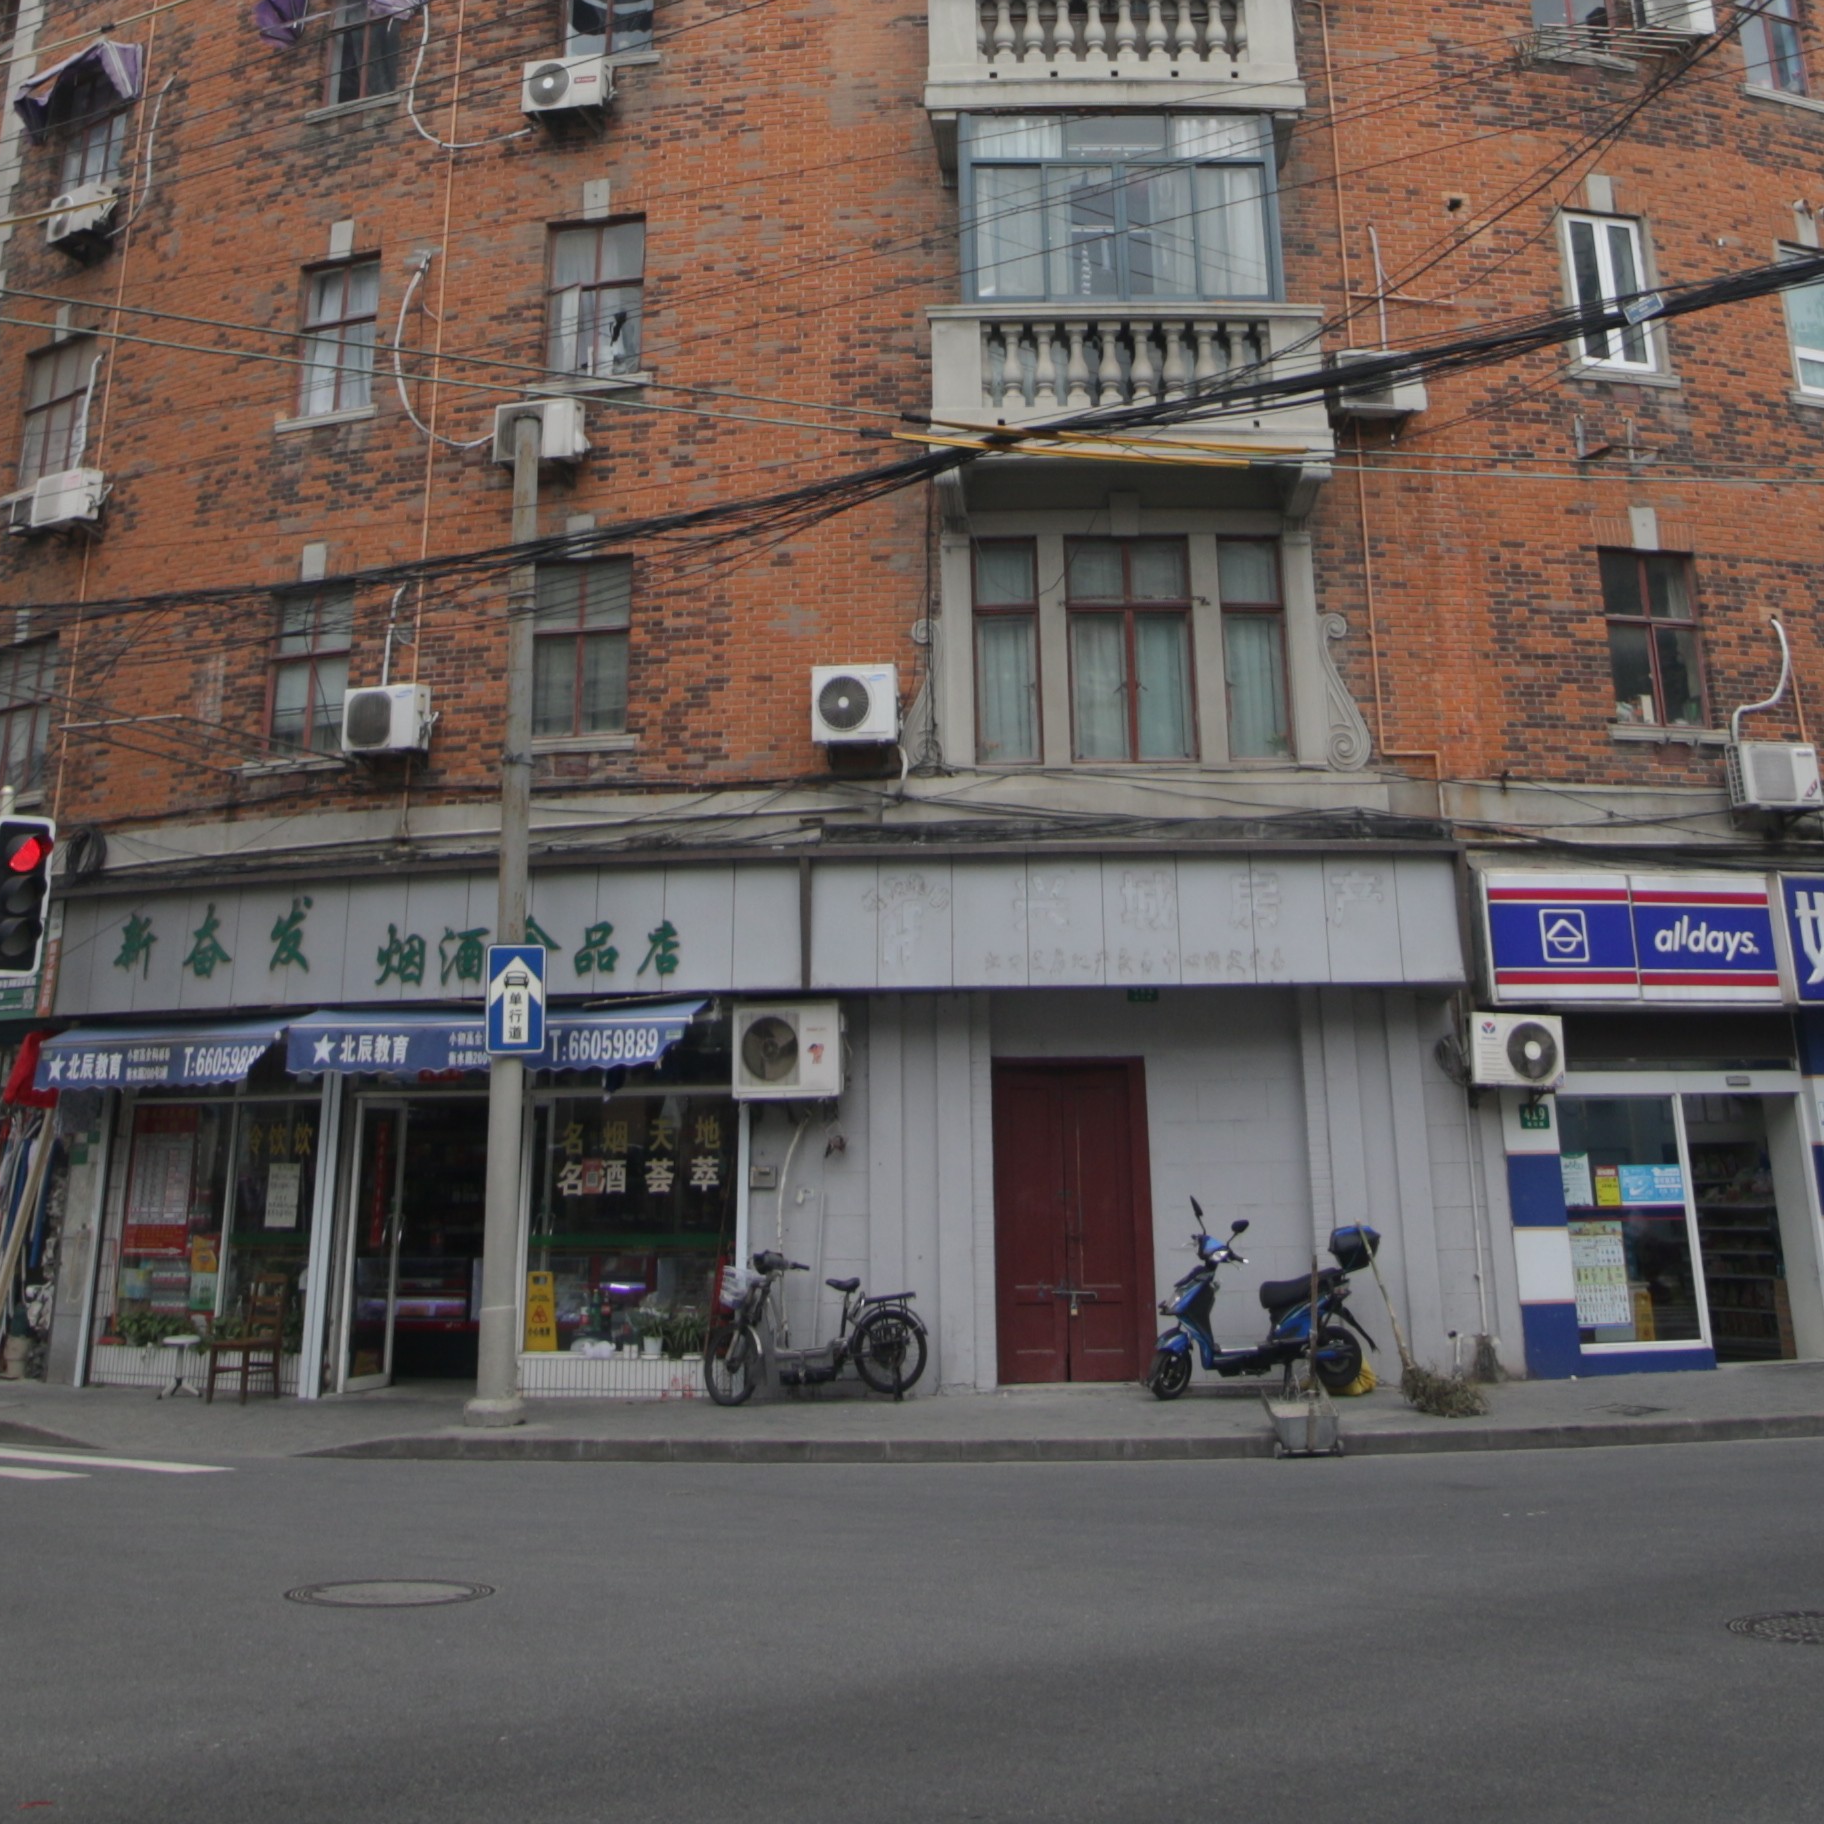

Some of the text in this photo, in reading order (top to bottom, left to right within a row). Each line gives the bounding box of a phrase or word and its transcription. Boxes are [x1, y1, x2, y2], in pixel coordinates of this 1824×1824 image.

[113, 895, 311, 980] 新奋发
[1654, 915, 1755, 961] alldays
[508, 992, 523, 1040] 单行道
[66, 1052, 123, 1081] 北辰教育
[339, 1033, 409, 1064] 北辰教育
[560, 1115, 721, 1155] 名烟天地
[557, 1155, 720, 1195] 名酒荟萃
